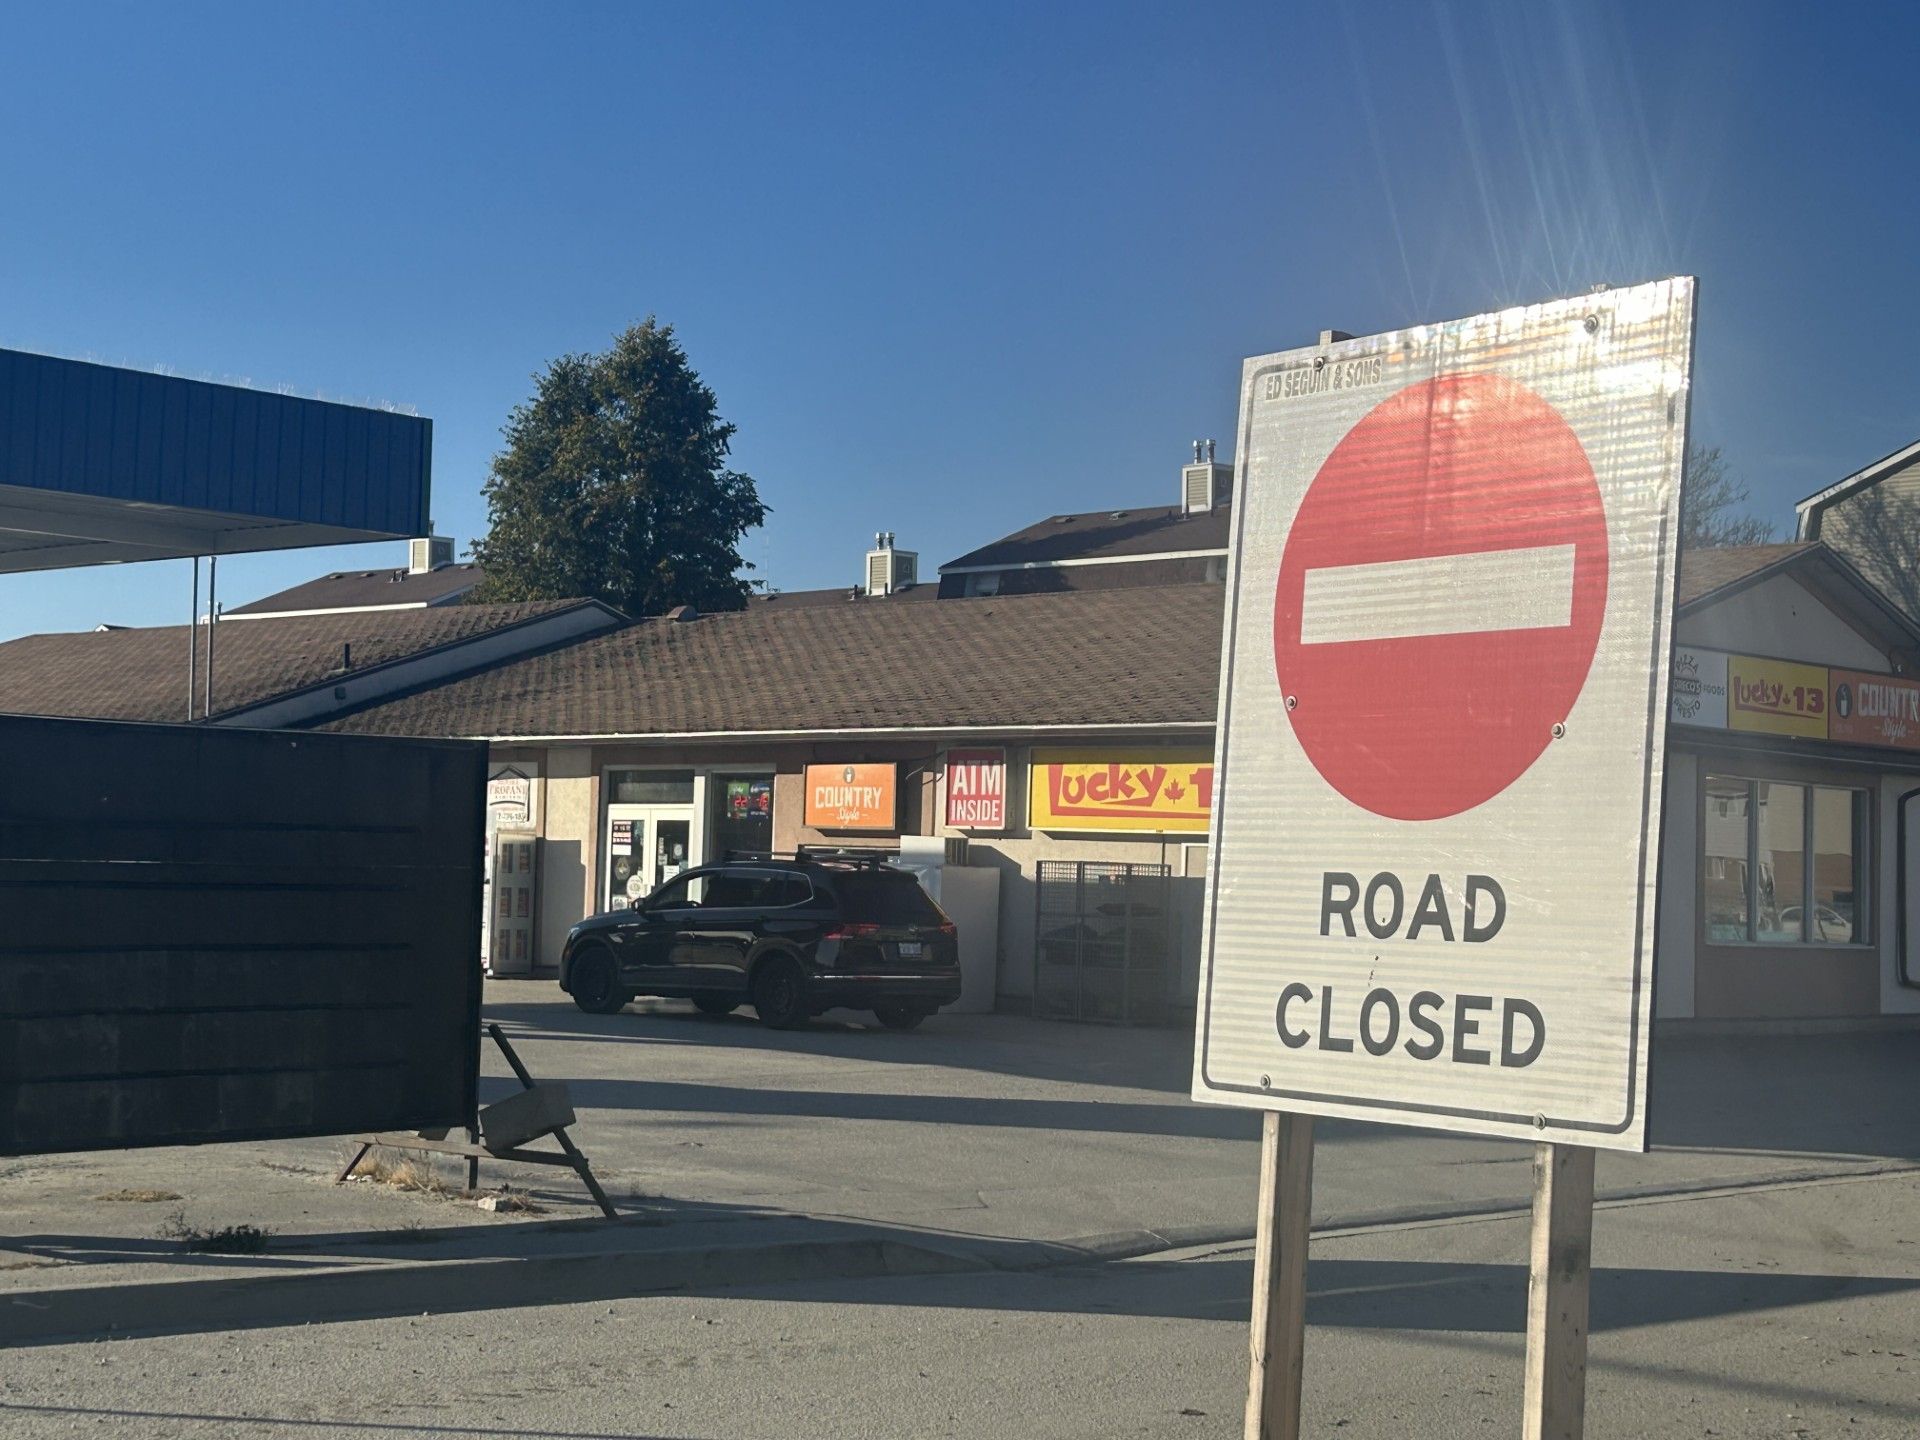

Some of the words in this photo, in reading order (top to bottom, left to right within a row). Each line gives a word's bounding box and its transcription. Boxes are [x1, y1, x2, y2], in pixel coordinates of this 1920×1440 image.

[1266, 375, 1282, 400] ED
[1284, 366, 1330, 398] SEGUIN
[1333, 364, 1343, 390] &
[1345, 358, 1381, 388] SONS
[1793, 687, 1825, 713] 13
[1858, 683, 1920, 722] COUNTR
[952, 760, 1000, 795] ATM
[1189, 767, 1214, 808] 1
[815, 786, 882, 809] COUNTRY
[836, 807, 860, 825] Style
[951, 799, 1000, 822] INSIDE
[1320, 872, 1506, 943] ROAD
[1276, 983, 1545, 1068] CLOSED
